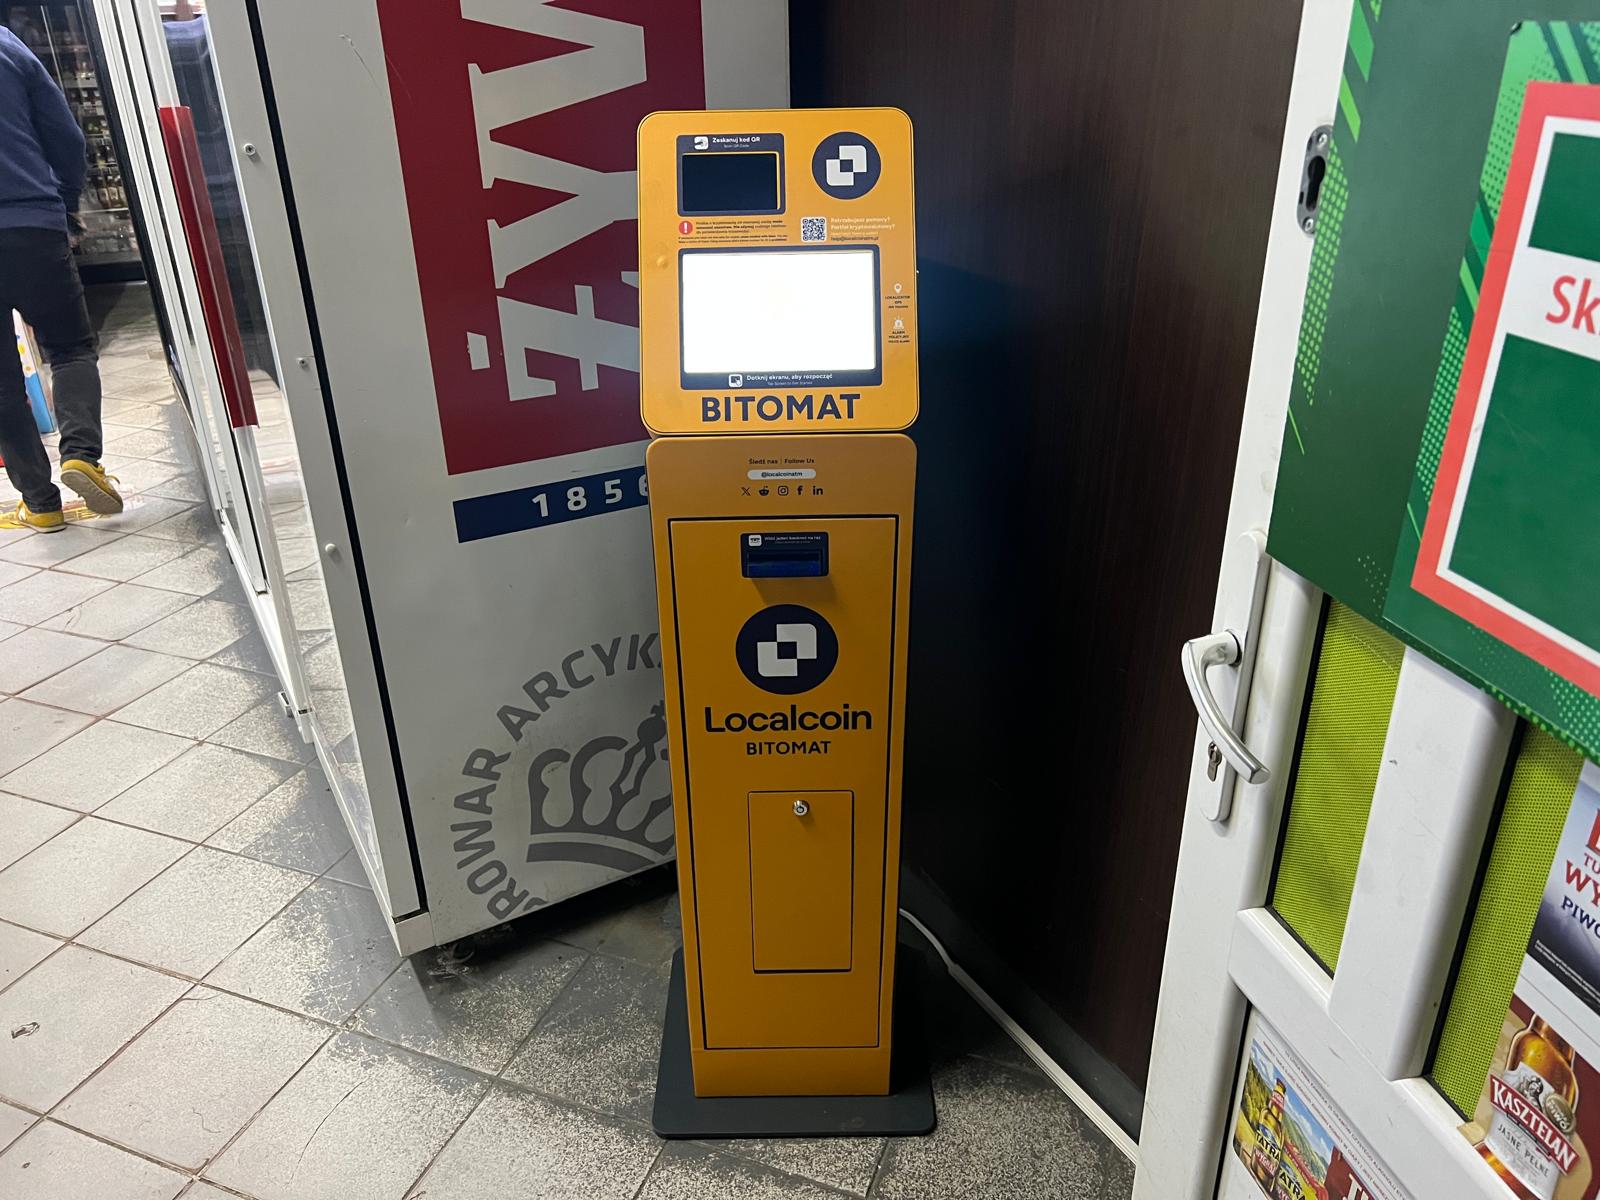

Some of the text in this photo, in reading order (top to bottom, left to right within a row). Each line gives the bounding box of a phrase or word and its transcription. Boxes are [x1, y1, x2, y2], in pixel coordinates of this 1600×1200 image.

[712, 136, 738, 144] Zeskanuj
[1545, 275, 1600, 335] Sk
[701, 393, 861, 422] BITOMAT
[496, 632, 661, 742] ARCYK
[704, 703, 872, 733] Localcoin
[746, 740, 831, 755] BITOMAT
[450, 748, 548, 920] ROWAR
[1491, 1077, 1576, 1171] KASZTELAN
[1498, 1122, 1522, 1150] JASNE
[1279, 1167, 1306, 1200] ATR
